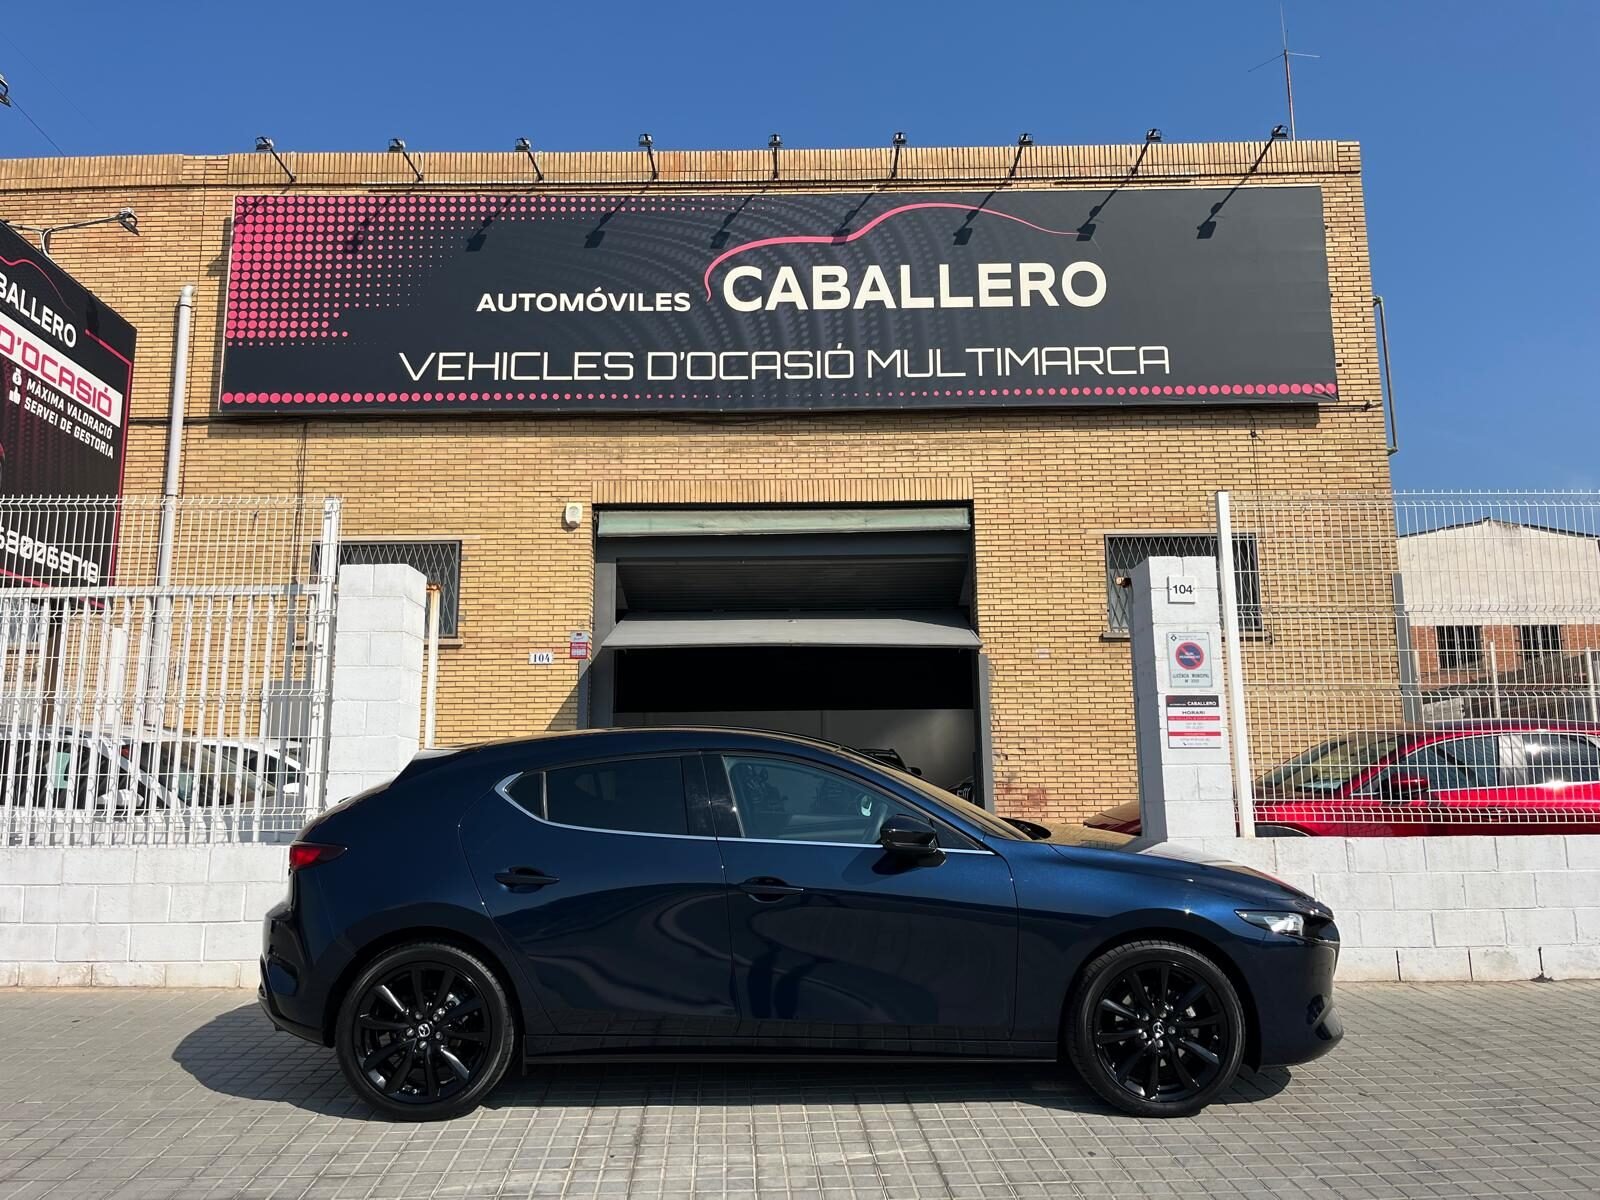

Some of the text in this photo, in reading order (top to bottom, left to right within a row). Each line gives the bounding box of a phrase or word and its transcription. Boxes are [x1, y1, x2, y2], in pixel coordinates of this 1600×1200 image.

[476, 261, 1108, 313] AUTOMÓVILES CABALLERO
[398, 342, 1170, 382] VEHICLES D'OCASIÓ MULTIMARCA
[24, 396, 114, 460] SERVEI DE GESTORIA
[26, 378, 113, 440] MÀXIMA VALORACIÓ
[1172, 584, 1193, 594] 104
[533, 653, 550, 663] 104
